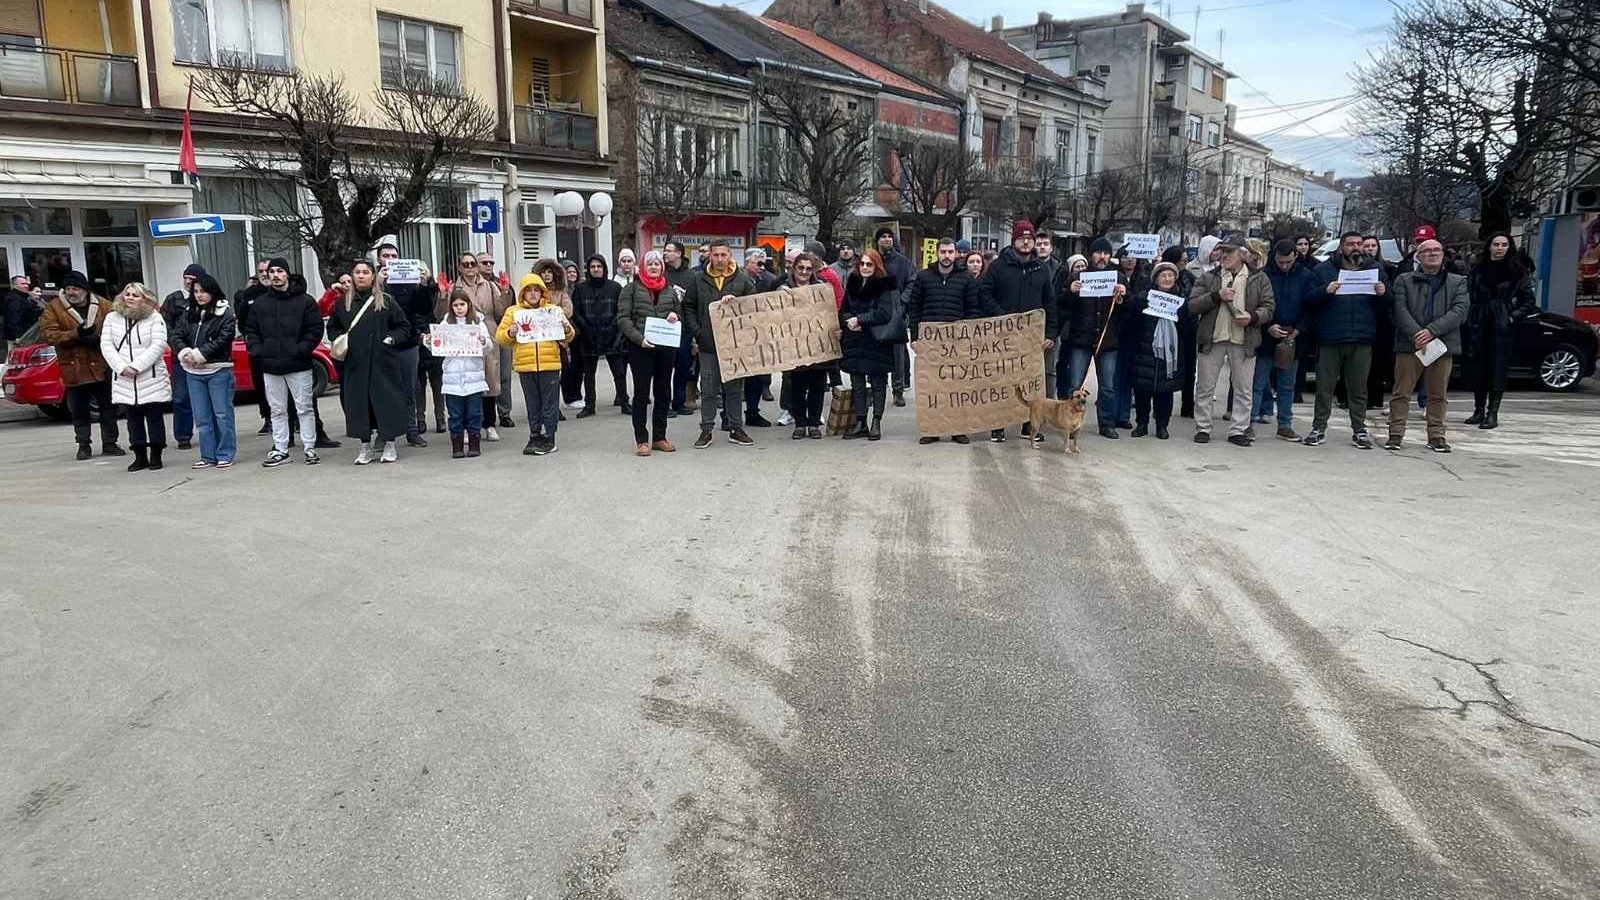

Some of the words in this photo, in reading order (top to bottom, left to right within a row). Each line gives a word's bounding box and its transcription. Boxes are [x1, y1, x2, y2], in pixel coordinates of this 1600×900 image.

[477, 205, 491, 229] P
[940, 344, 958, 358] ЗА
[969, 338, 1010, 361] ЂАКЕ
[938, 355, 1029, 380] СТУДЕНТЕ
[928, 394, 937, 409] И
